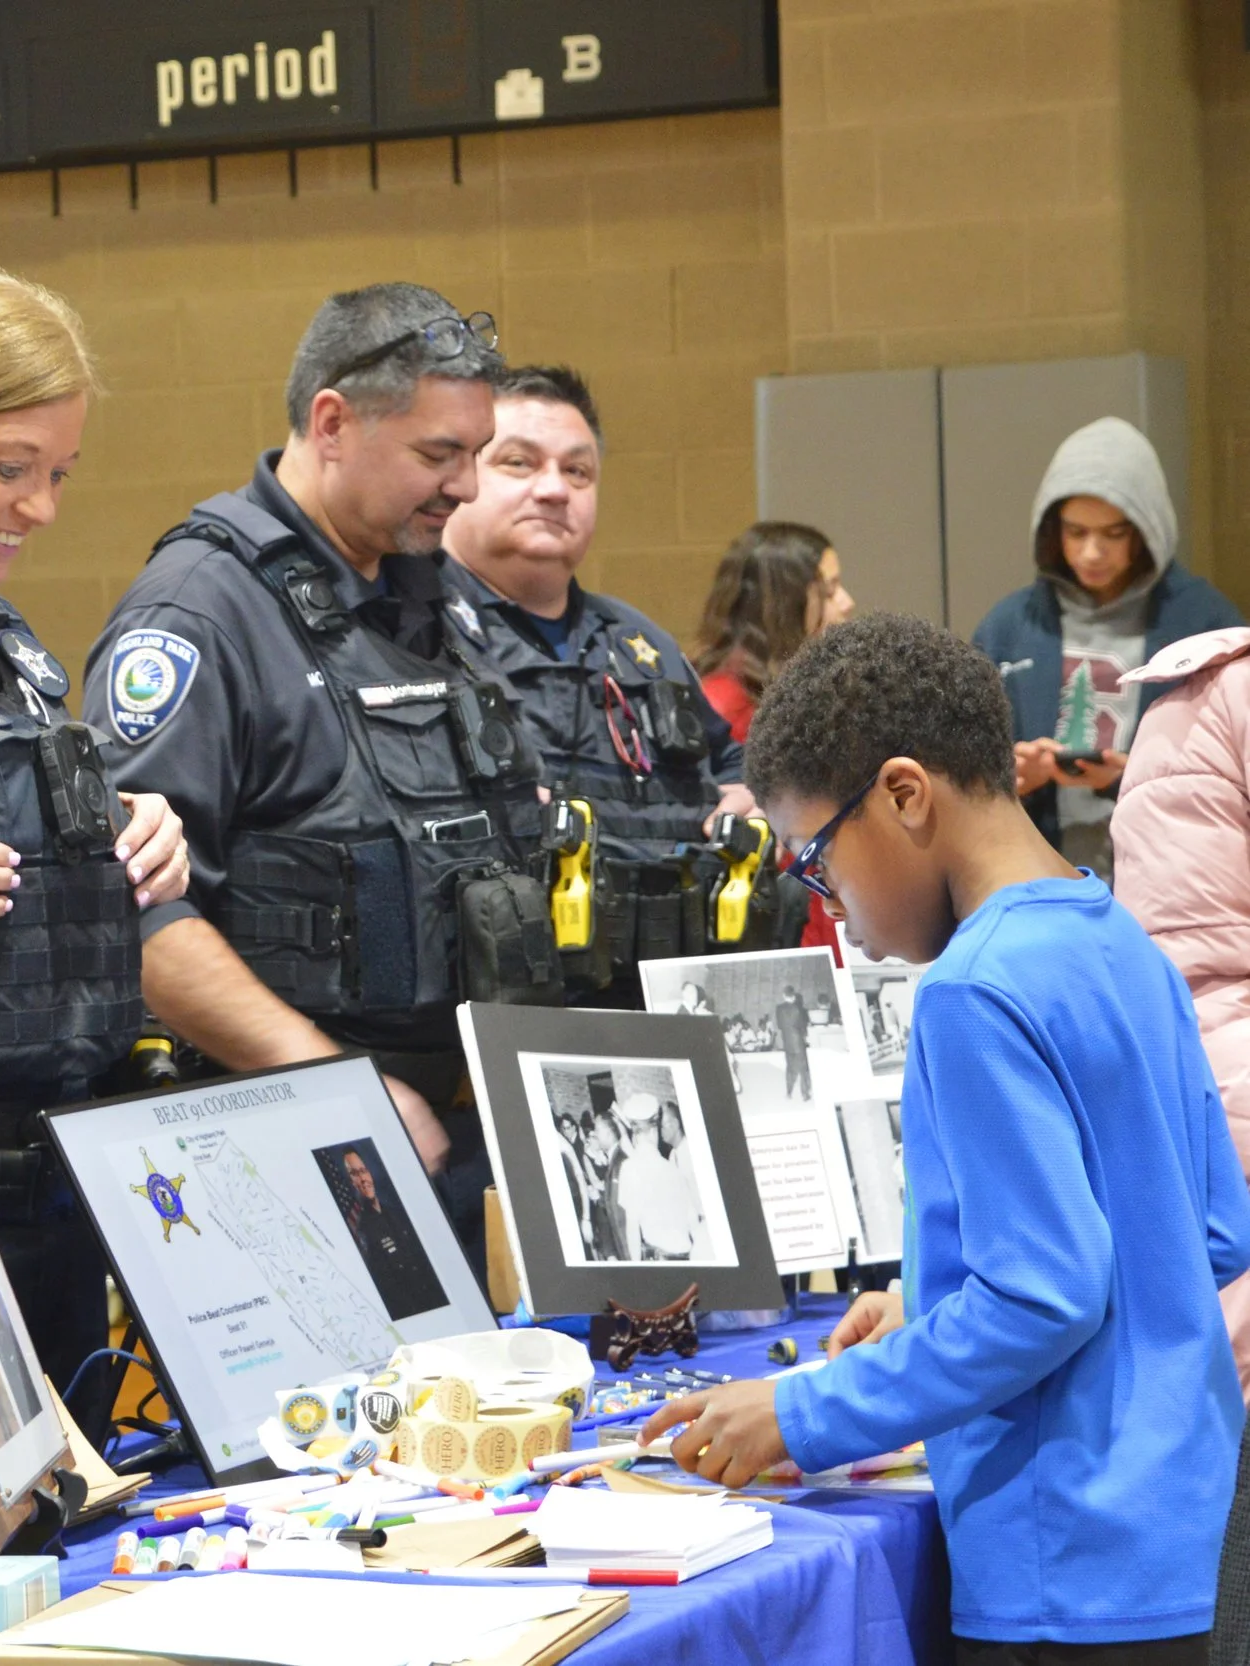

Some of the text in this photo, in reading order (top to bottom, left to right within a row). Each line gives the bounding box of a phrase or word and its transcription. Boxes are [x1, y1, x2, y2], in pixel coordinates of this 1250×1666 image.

[562, 35, 602, 83] B
[158, 31, 338, 126] period
[115, 635, 192, 663] HIGHLAND PARK
[116, 711, 158, 726] POLICE
[153, 1082, 297, 1126] BEAT 91 COORDINATOR
[452, 1383, 464, 1420] HERO
[442, 1431, 454, 1469] HERO
[494, 1432, 506, 1470] HERO
